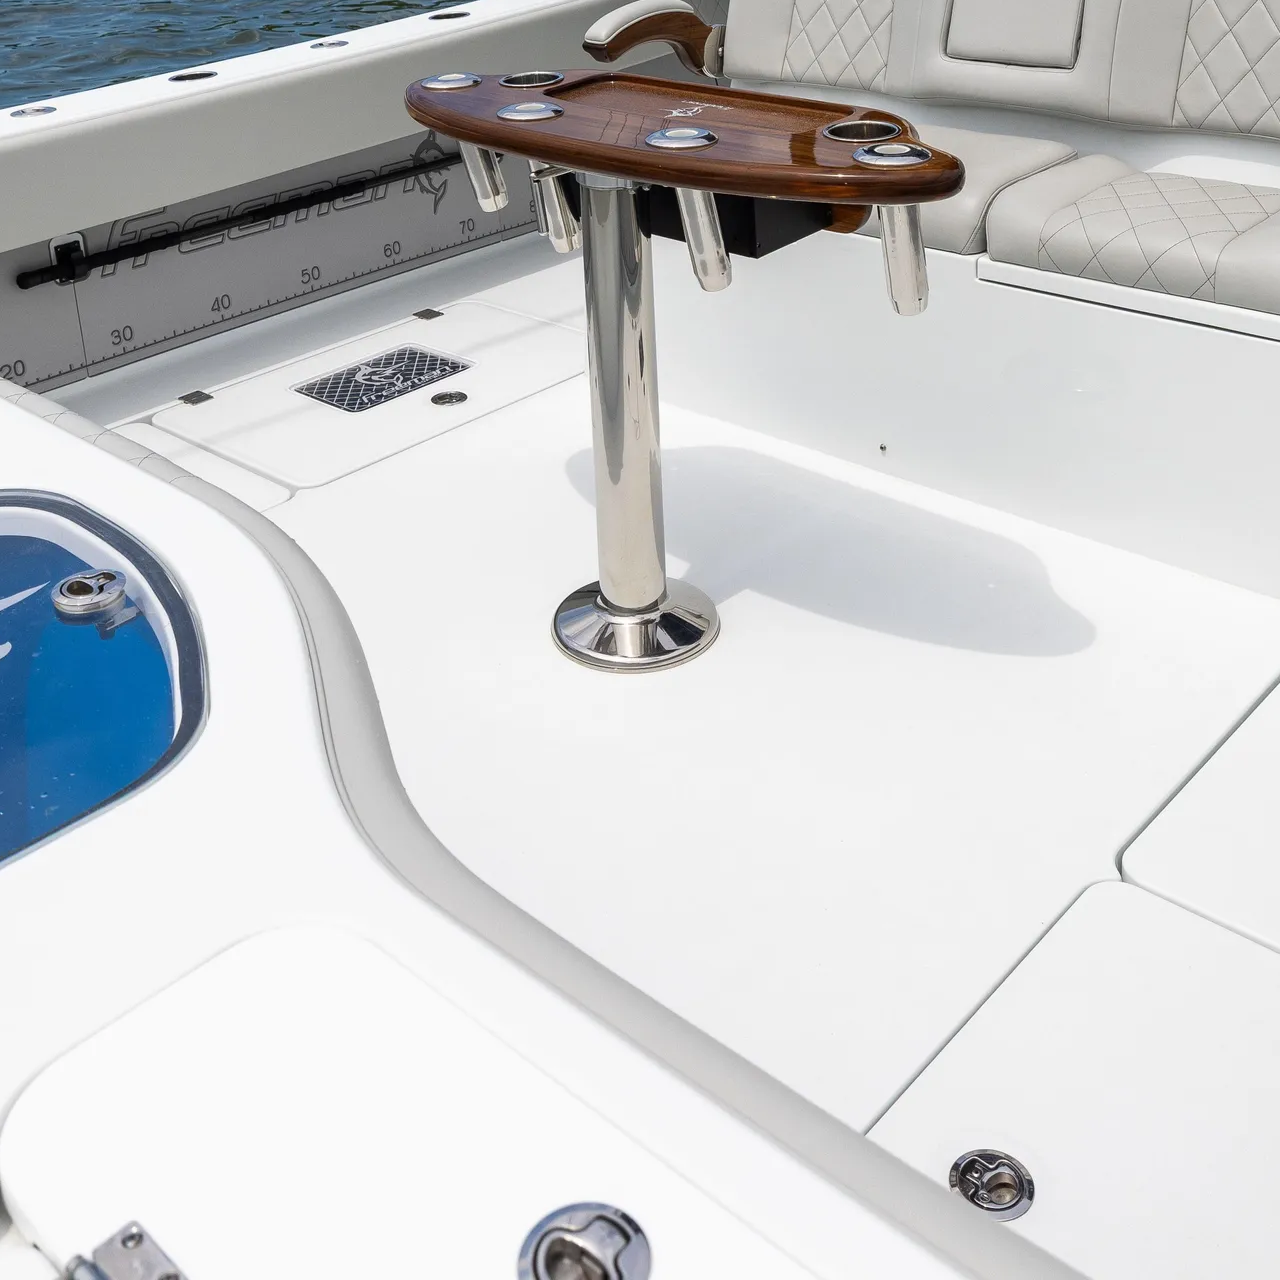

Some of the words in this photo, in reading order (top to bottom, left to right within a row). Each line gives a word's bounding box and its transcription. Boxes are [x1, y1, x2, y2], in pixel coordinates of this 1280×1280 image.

[0, 360, 26, 380] 20
[110, 325, 133, 346] 30
[210, 293, 231, 314] 40
[300, 265, 321, 285] 50
[383, 240, 401, 258] 60
[459, 217, 475, 235] 70
